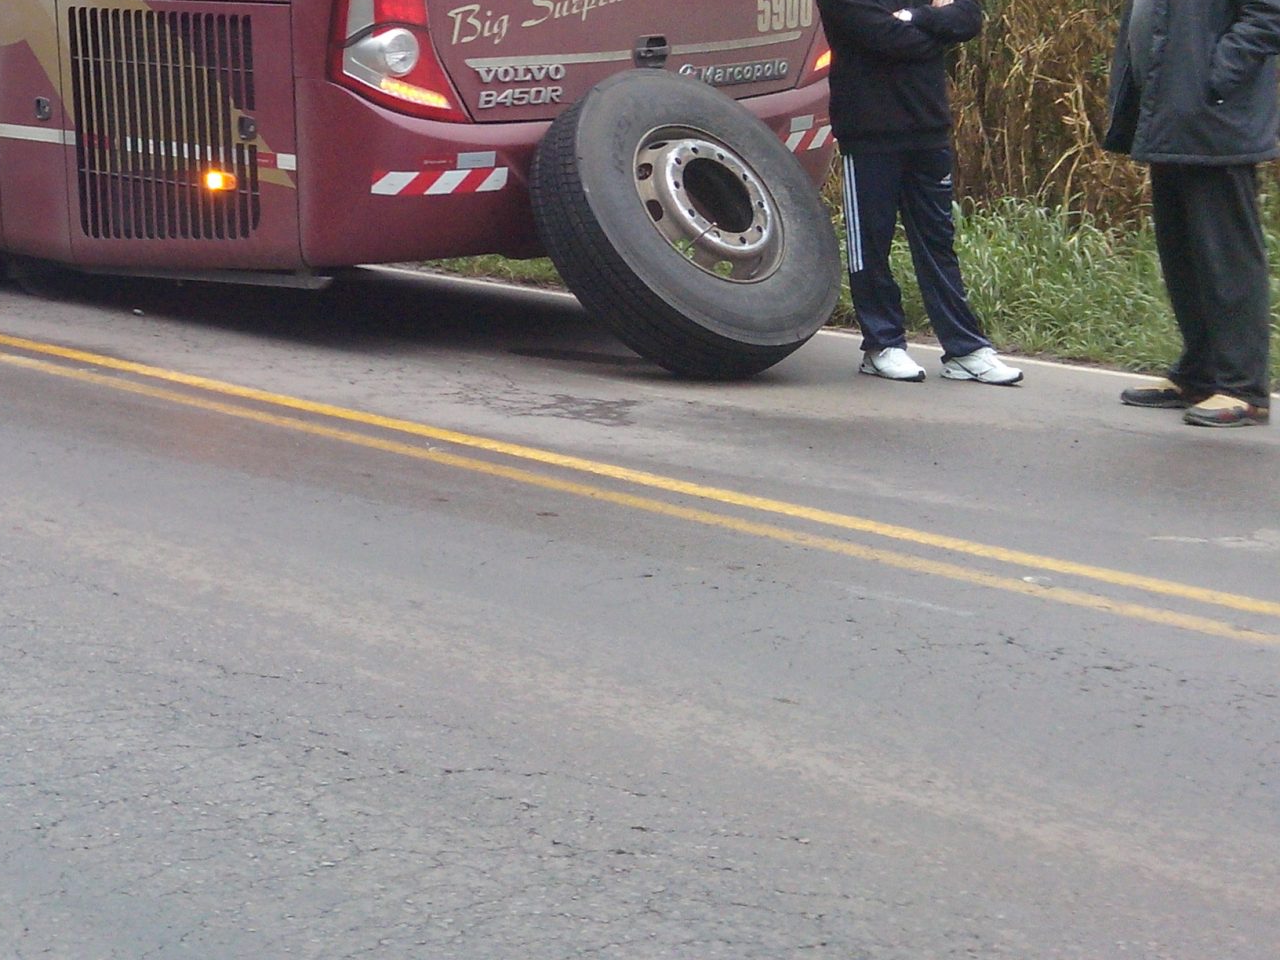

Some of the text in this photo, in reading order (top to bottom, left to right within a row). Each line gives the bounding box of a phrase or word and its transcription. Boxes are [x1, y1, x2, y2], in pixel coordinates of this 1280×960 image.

[447, 4, 510, 45] Big
[475, 64, 566, 84] VOLVO
[700, 59, 789, 82] Marcopolo
[478, 86, 563, 110] B450R
